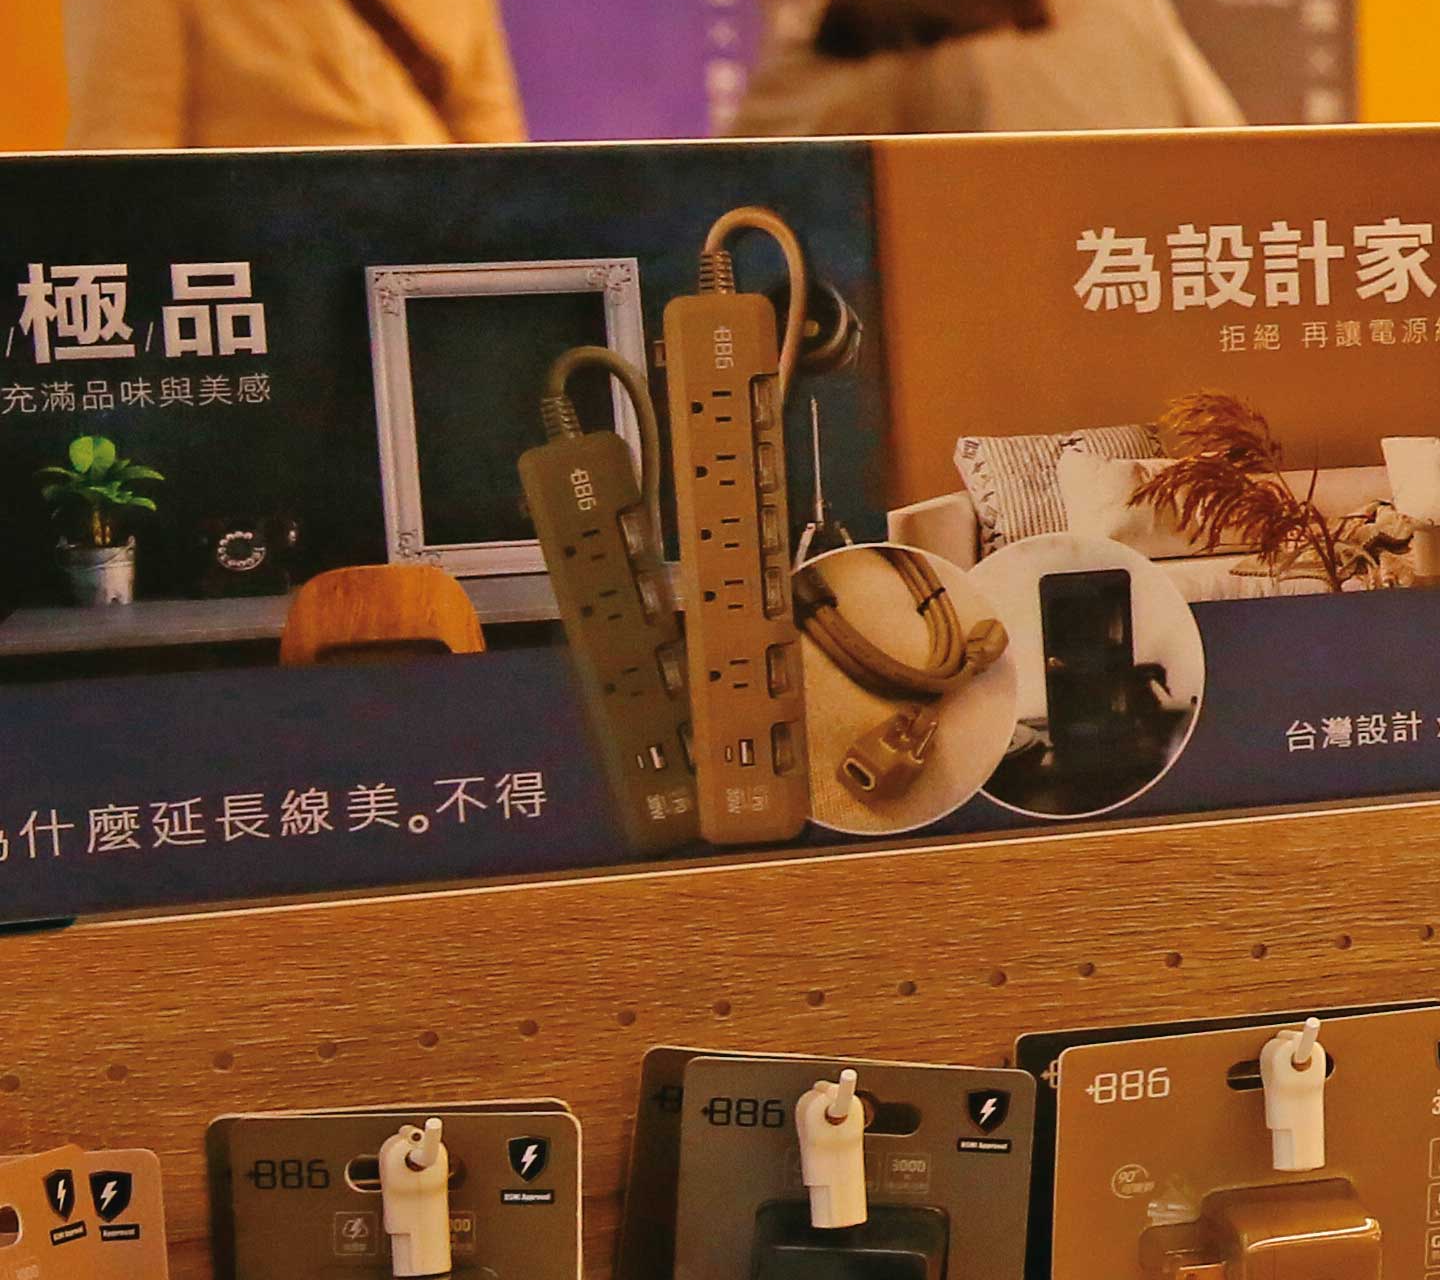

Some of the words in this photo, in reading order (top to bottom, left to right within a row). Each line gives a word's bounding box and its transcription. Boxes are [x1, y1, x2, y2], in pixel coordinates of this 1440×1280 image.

[1220, 322, 1283, 352] 拒絕
[2, 372, 271, 415] 充滿品味與美感
[1285, 712, 1421, 753] 台灣設計
[0, 773, 547, 863] 什麼延長線美。不得
